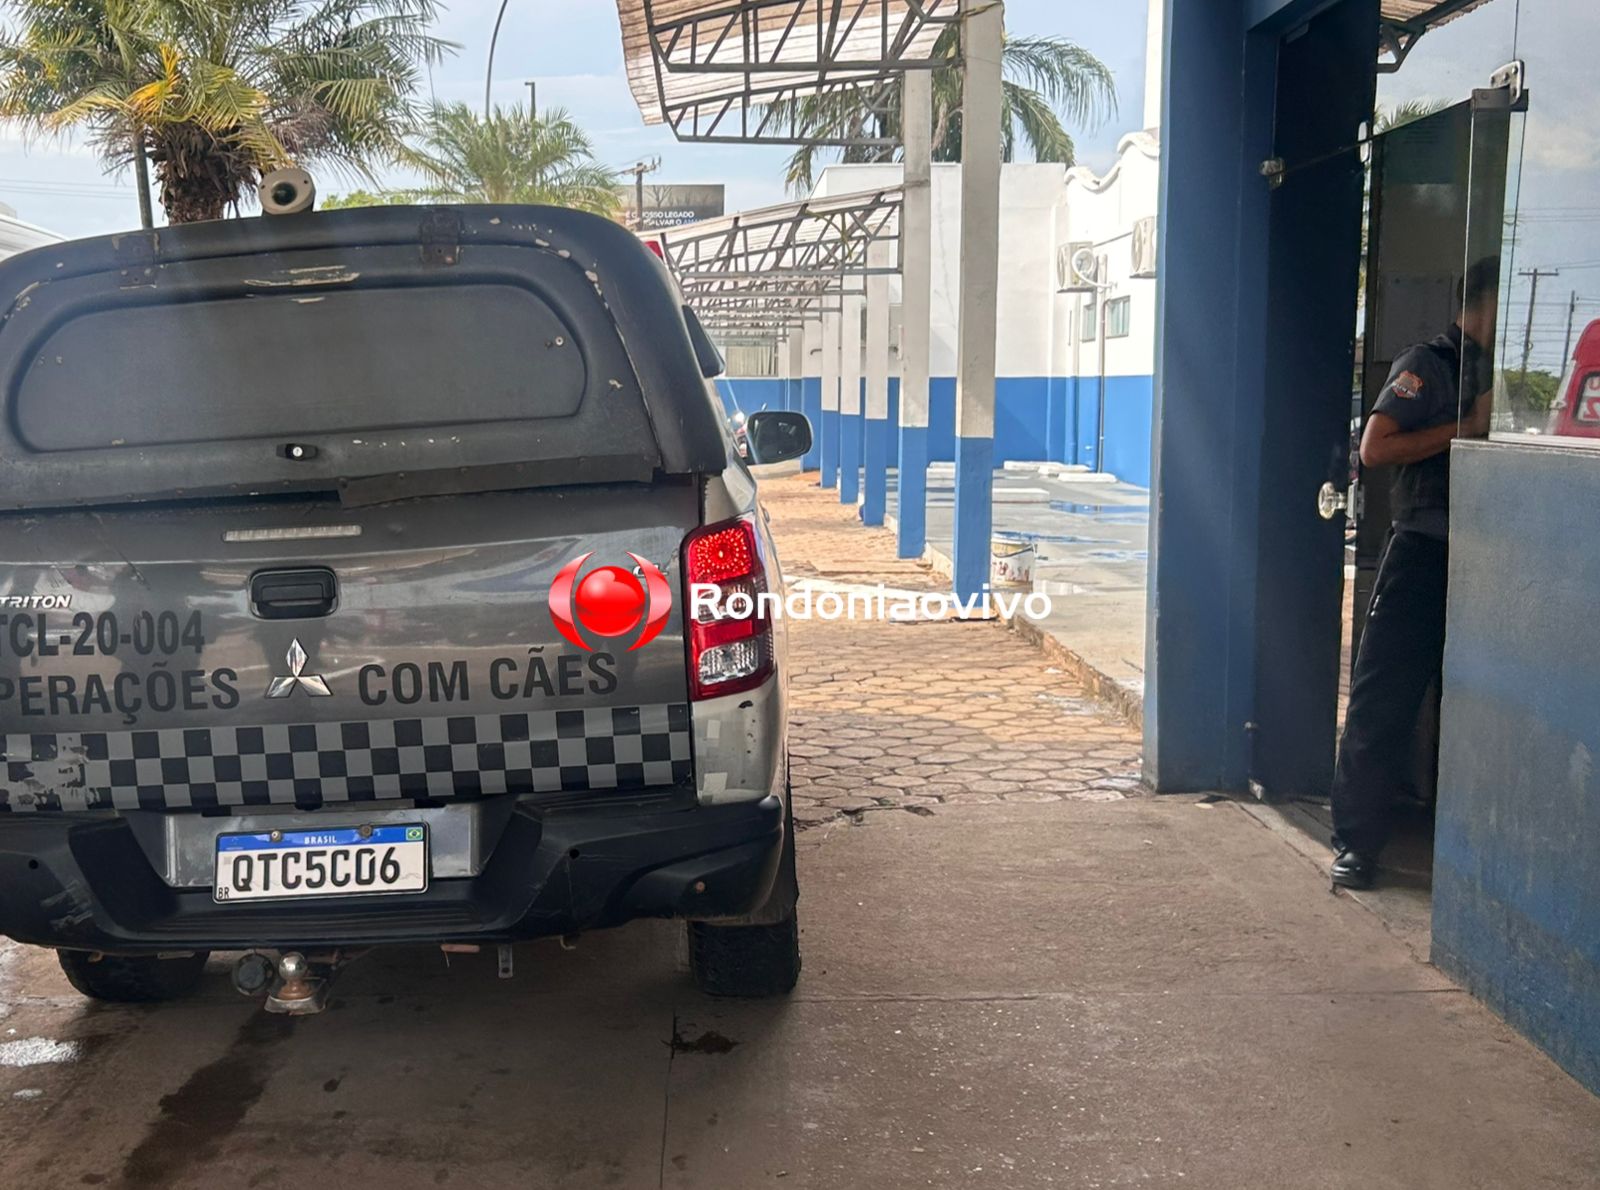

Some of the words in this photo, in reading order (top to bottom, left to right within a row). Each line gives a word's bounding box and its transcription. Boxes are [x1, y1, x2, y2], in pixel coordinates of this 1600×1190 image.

[664, 211, 695, 219] LEGADO
[0, 594, 71, 608] TRITON
[358, 660, 470, 706] COM
[489, 645, 618, 699] CÃES
[303, 835, 337, 845] BRASIL
[232, 847, 400, 892] QTC5C06
[218, 887, 230, 899] BR
